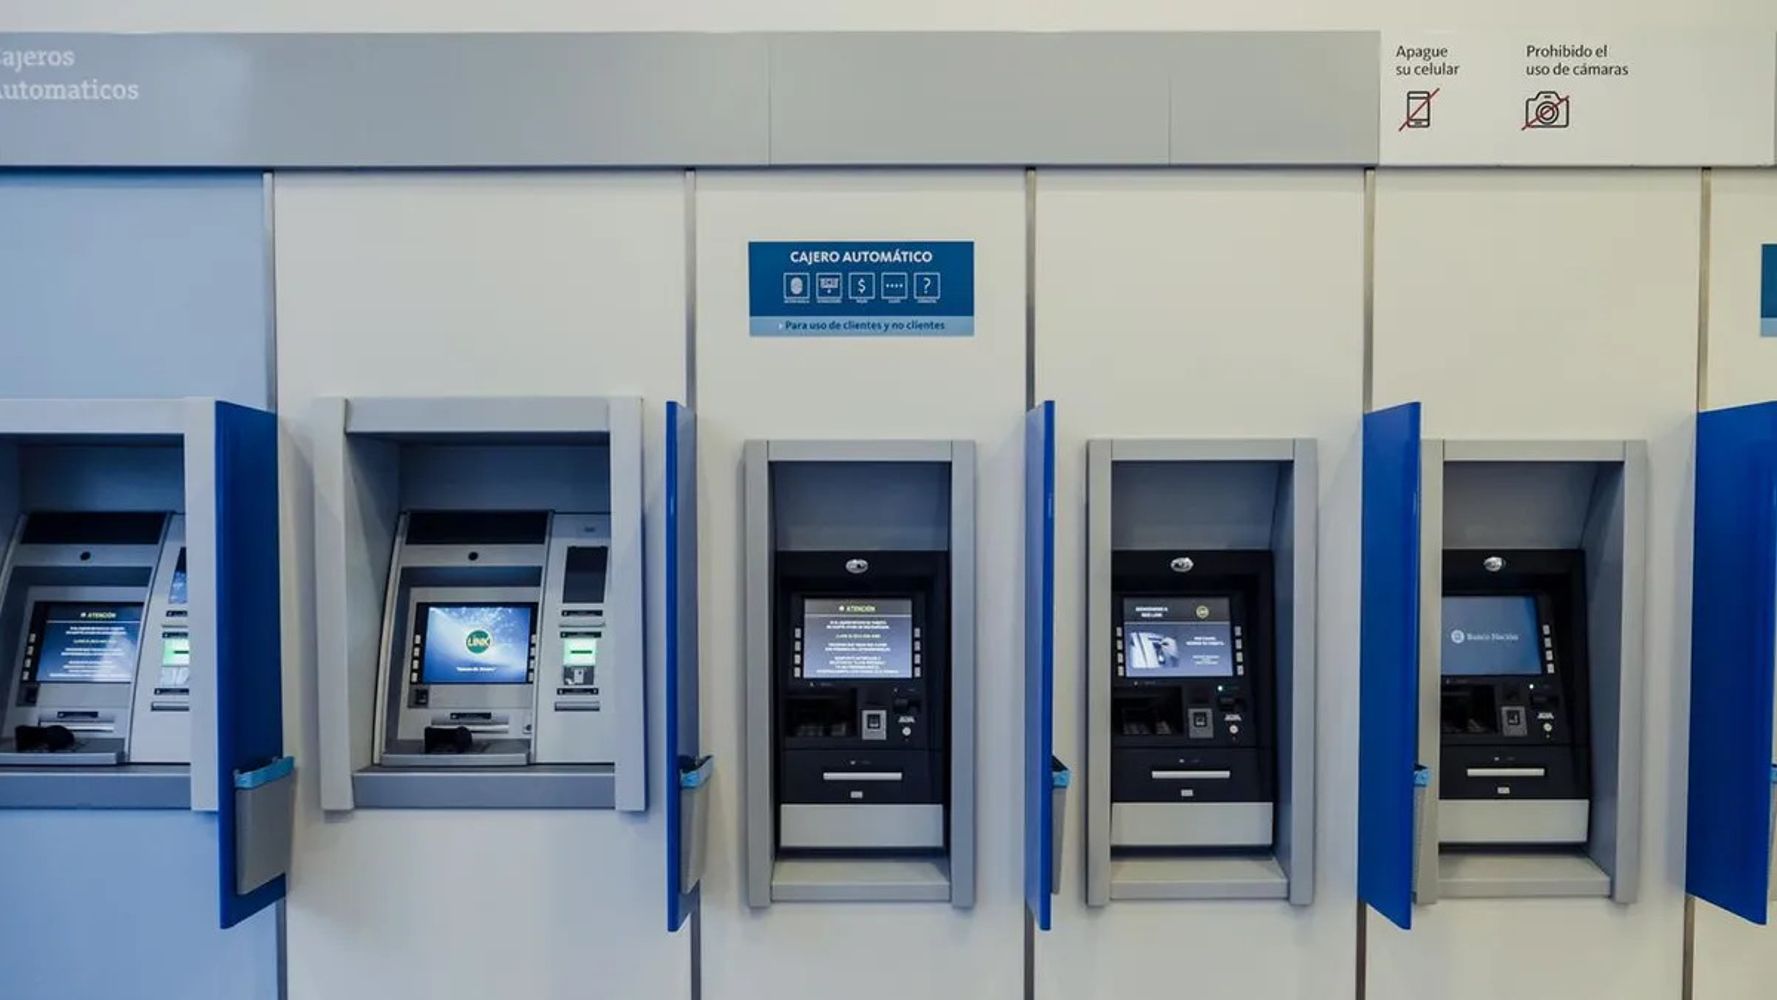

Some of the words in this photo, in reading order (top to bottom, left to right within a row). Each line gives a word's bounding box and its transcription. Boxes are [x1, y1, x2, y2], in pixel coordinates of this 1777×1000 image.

[1396, 45, 1448, 60] Apague
[1526, 45, 1593, 58] Prohibido
[1595, 45, 1608, 58] el
[0, 50, 75, 72] ajeros
[1396, 65, 1411, 76] su
[1414, 62, 1460, 76] celular
[1526, 66, 1549, 76] uso
[1553, 62, 1570, 76] de
[1573, 63, 1629, 76] cámaras
[790, 251, 840, 265] CAJERO
[842, 249, 933, 263] AUTOMÁTICO
[785, 320, 808, 330] Para
[810, 322, 827, 330] uso
[829, 320, 842, 330] de
[843, 319, 882, 330] clientes
[883, 322, 890, 332] y
[892, 322, 905, 330] no
[906, 319, 945, 330] clientes
[468, 635, 490, 648] LINK
